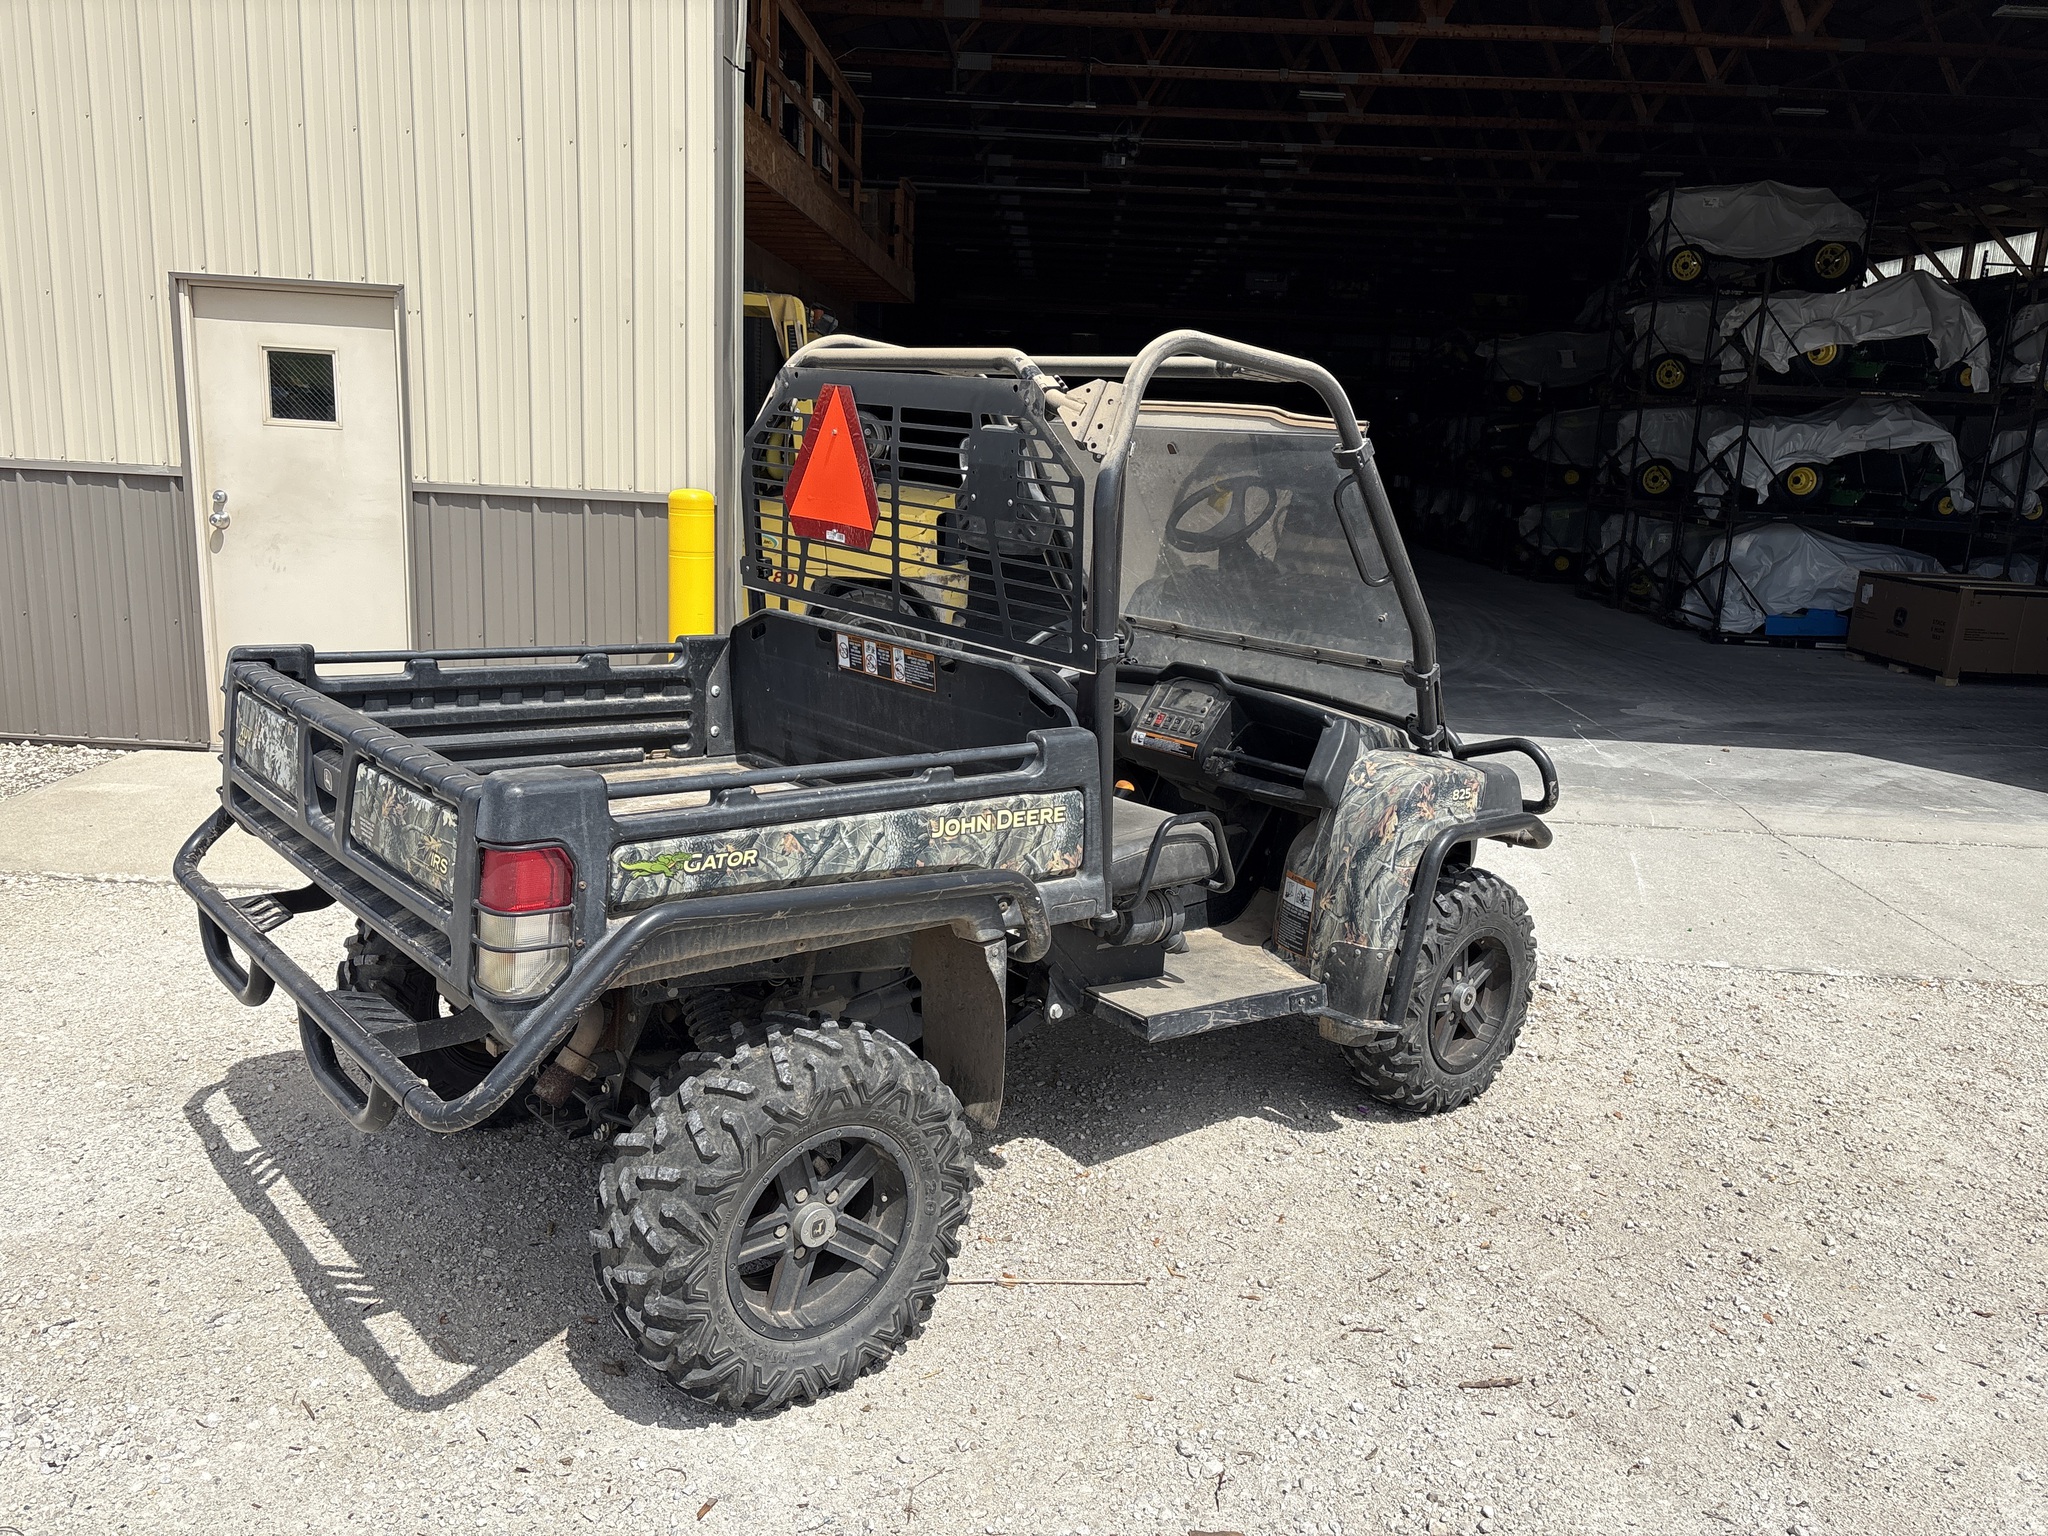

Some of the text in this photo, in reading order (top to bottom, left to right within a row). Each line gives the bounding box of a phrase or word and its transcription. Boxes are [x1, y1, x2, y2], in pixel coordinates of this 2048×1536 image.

[1452, 788, 1472, 801] 825
[931, 806, 1067, 839] JOHN DEERE
[431, 852, 448, 874] IRS
[683, 849, 758, 874] GATOR
[865, 1109, 935, 1173] BIGHORN
[924, 1179, 938, 1217] 2.0
[716, 1307, 790, 1363] MAXXIS
